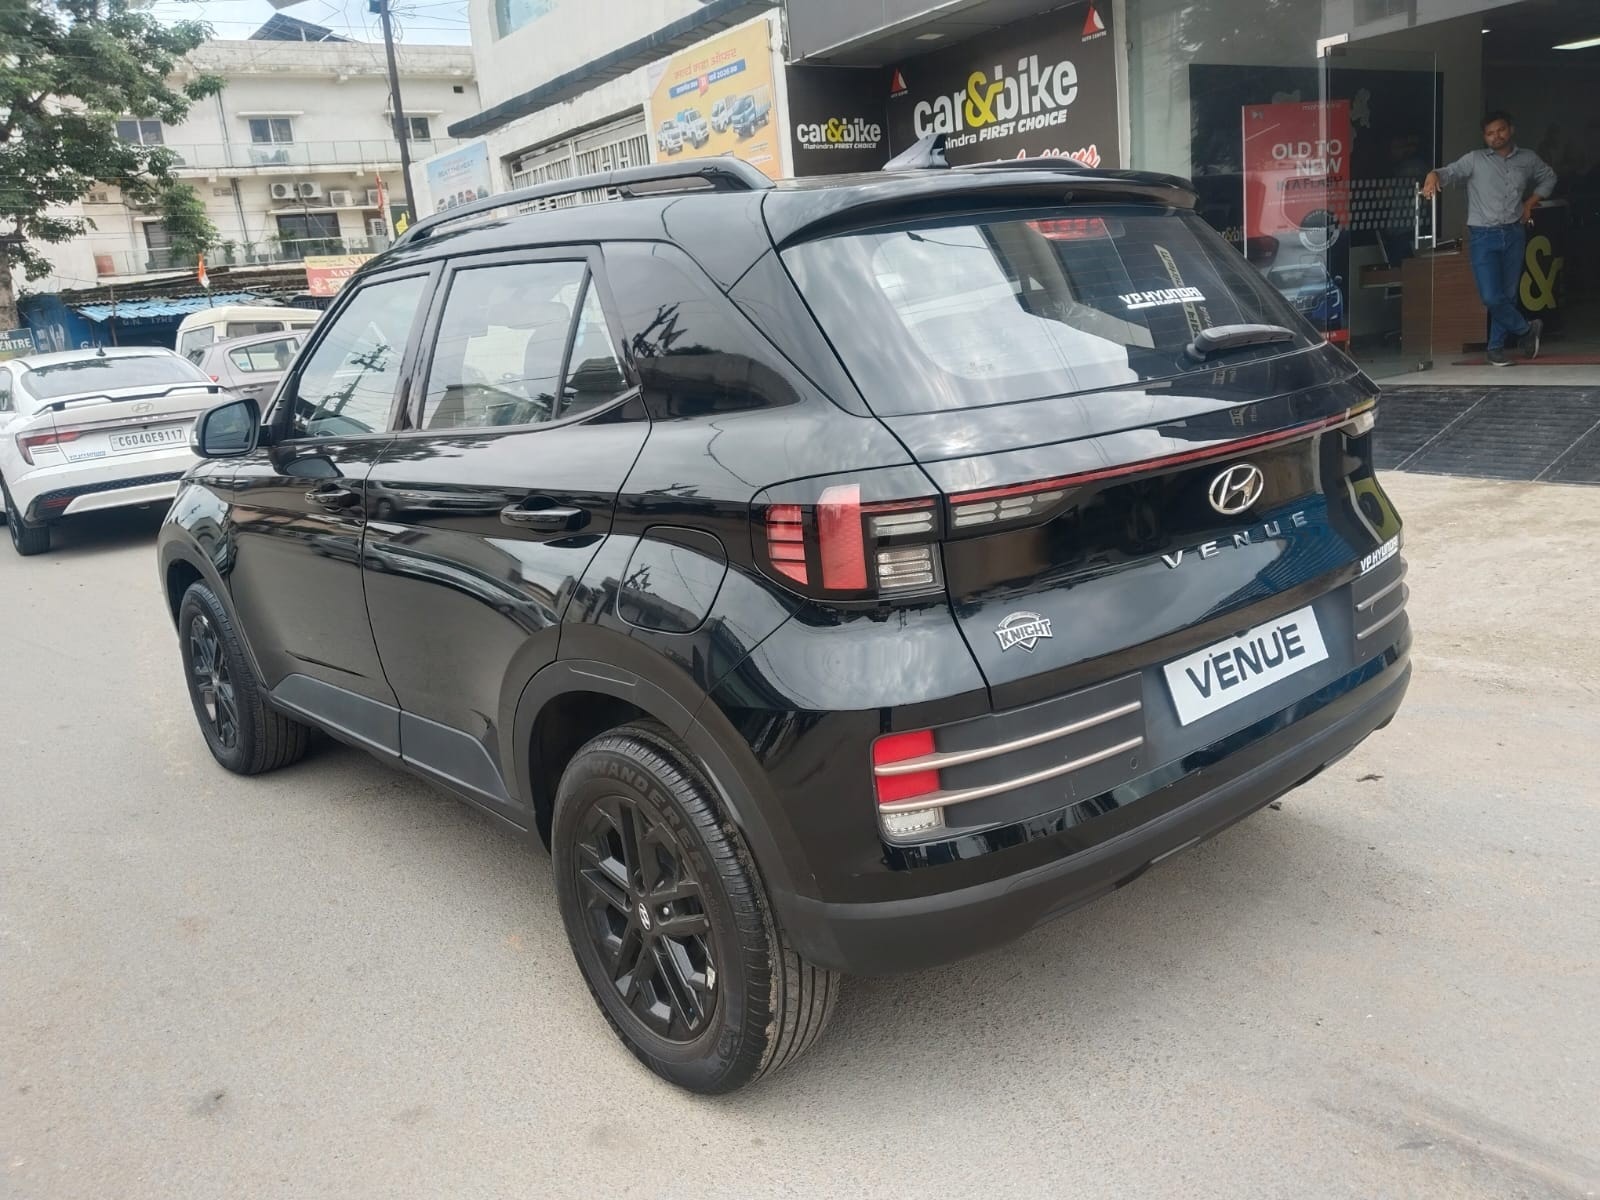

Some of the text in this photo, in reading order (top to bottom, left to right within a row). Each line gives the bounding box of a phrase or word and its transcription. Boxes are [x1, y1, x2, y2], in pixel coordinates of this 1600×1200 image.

[914, 55, 1078, 141] car&bike
[797, 118, 882, 143] car&bike
[979, 122, 1016, 141] FIRST
[1017, 109, 1068, 133] CHOICE
[1272, 139, 1342, 160] OLD TO
[1296, 157, 1342, 177] NEW
[1118, 286, 1203, 305] VP HYUNDAI
[1160, 510, 1309, 569] VENUE
[1360, 554, 1372, 571] VP
[999, 620, 1051, 648] KNIGHT
[1185, 623, 1306, 699] VENUE
